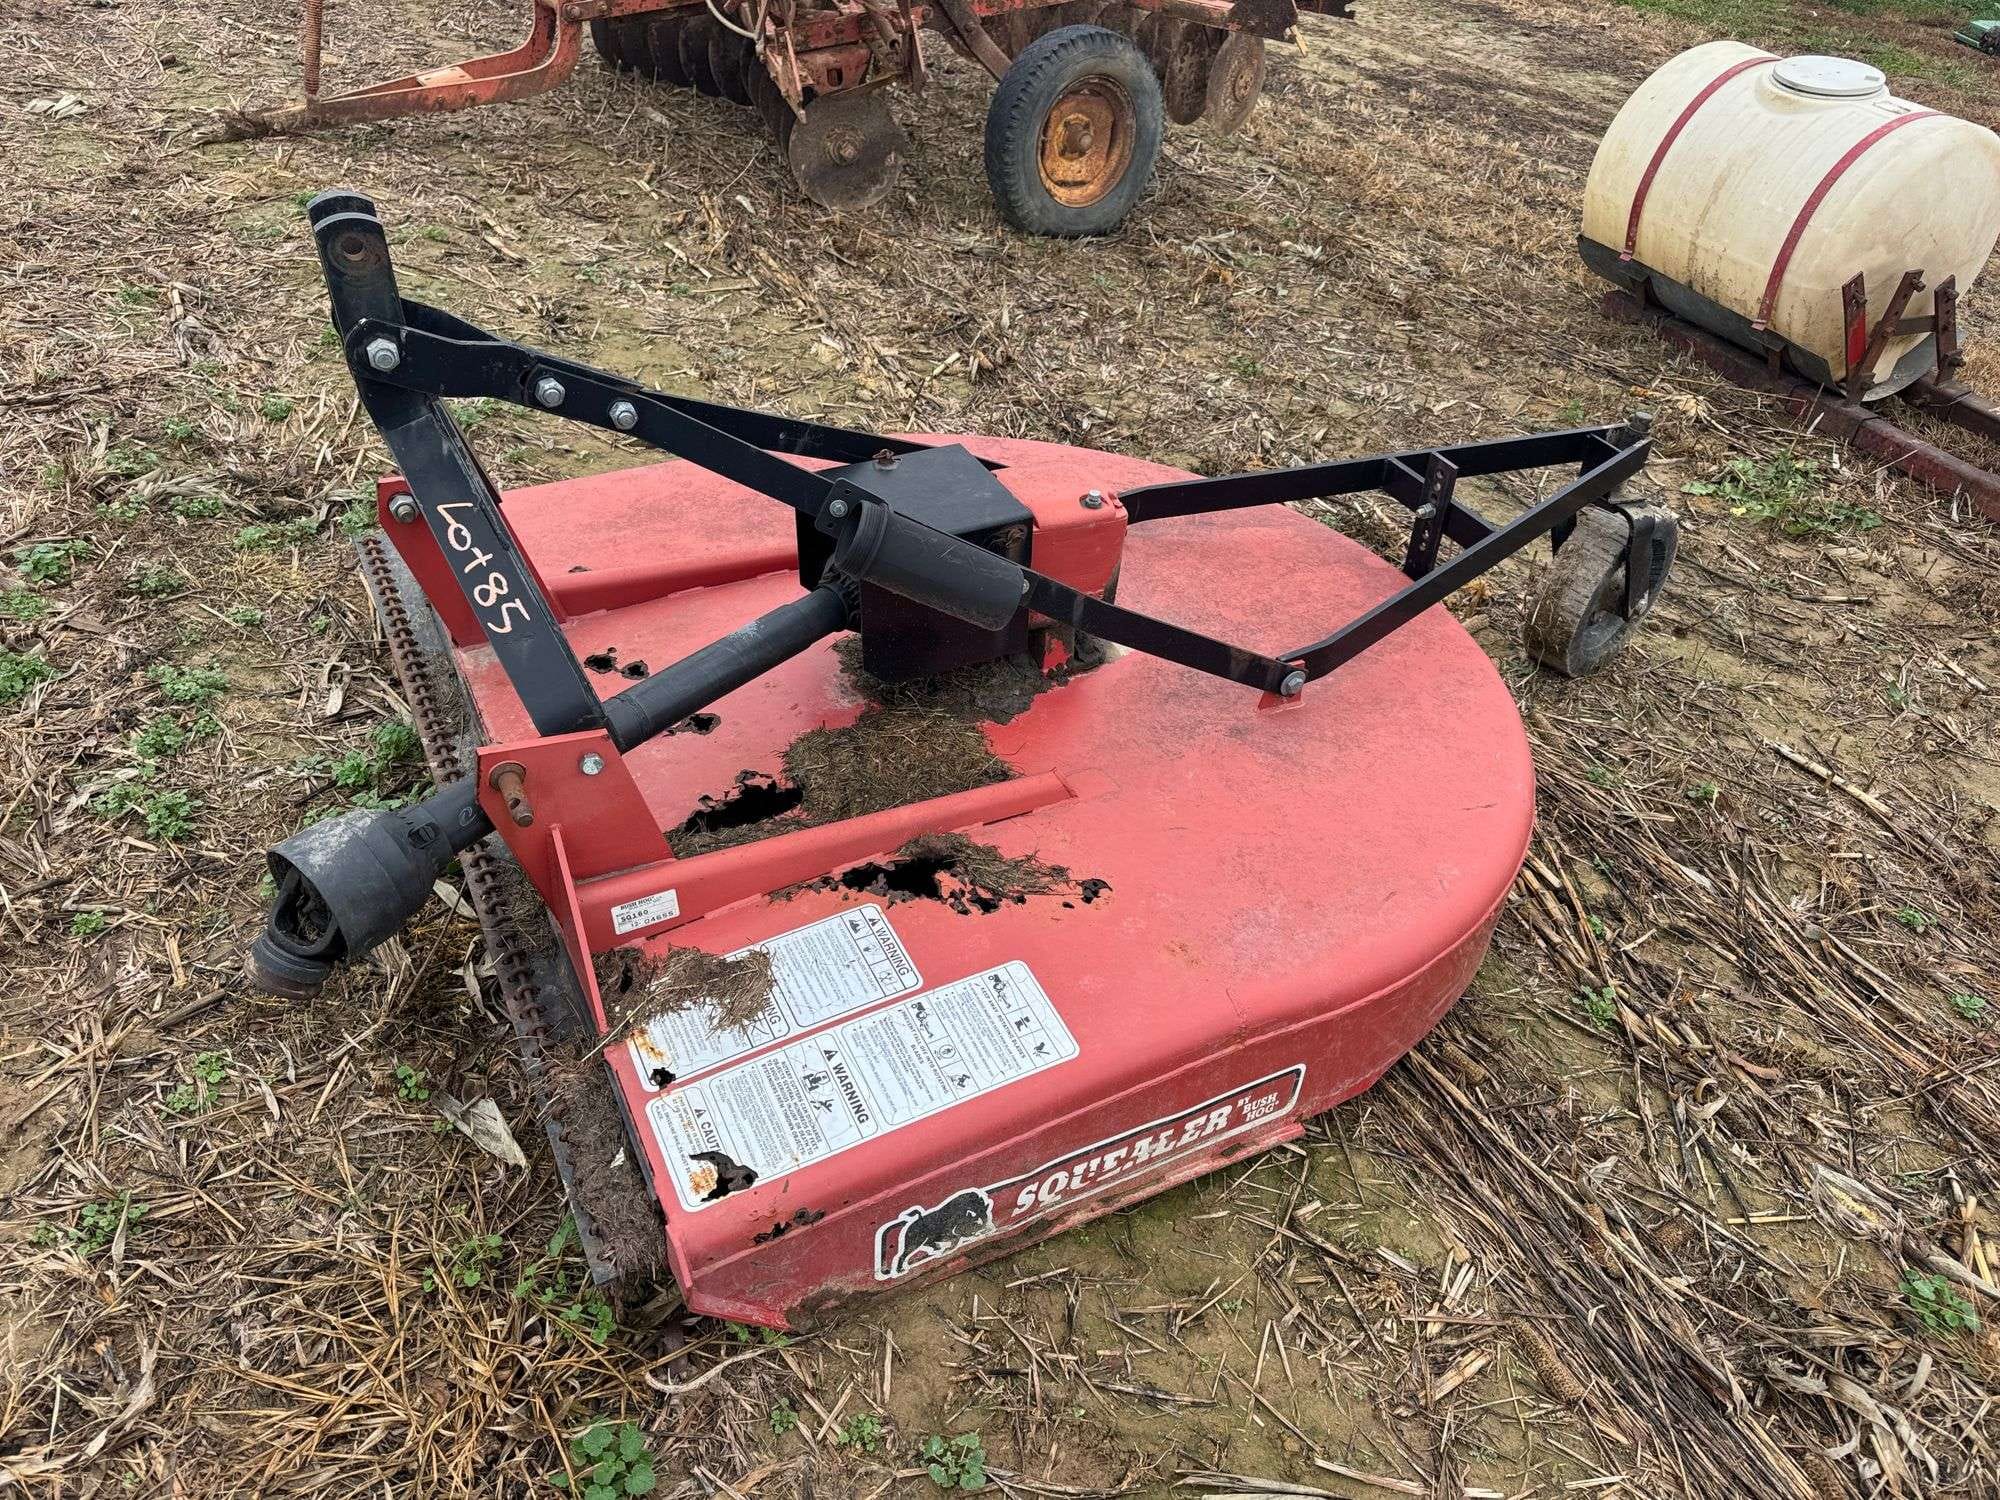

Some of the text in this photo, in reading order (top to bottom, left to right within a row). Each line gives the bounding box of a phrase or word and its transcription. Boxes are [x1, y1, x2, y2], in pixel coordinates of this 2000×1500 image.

[473, 571, 531, 634] 85
[875, 926, 910, 976] WARNING
[832, 1062, 870, 1124] WARNING
[1242, 1092, 1279, 1115] BUSH
[1011, 1095, 1252, 1218] SQUEALER BY
